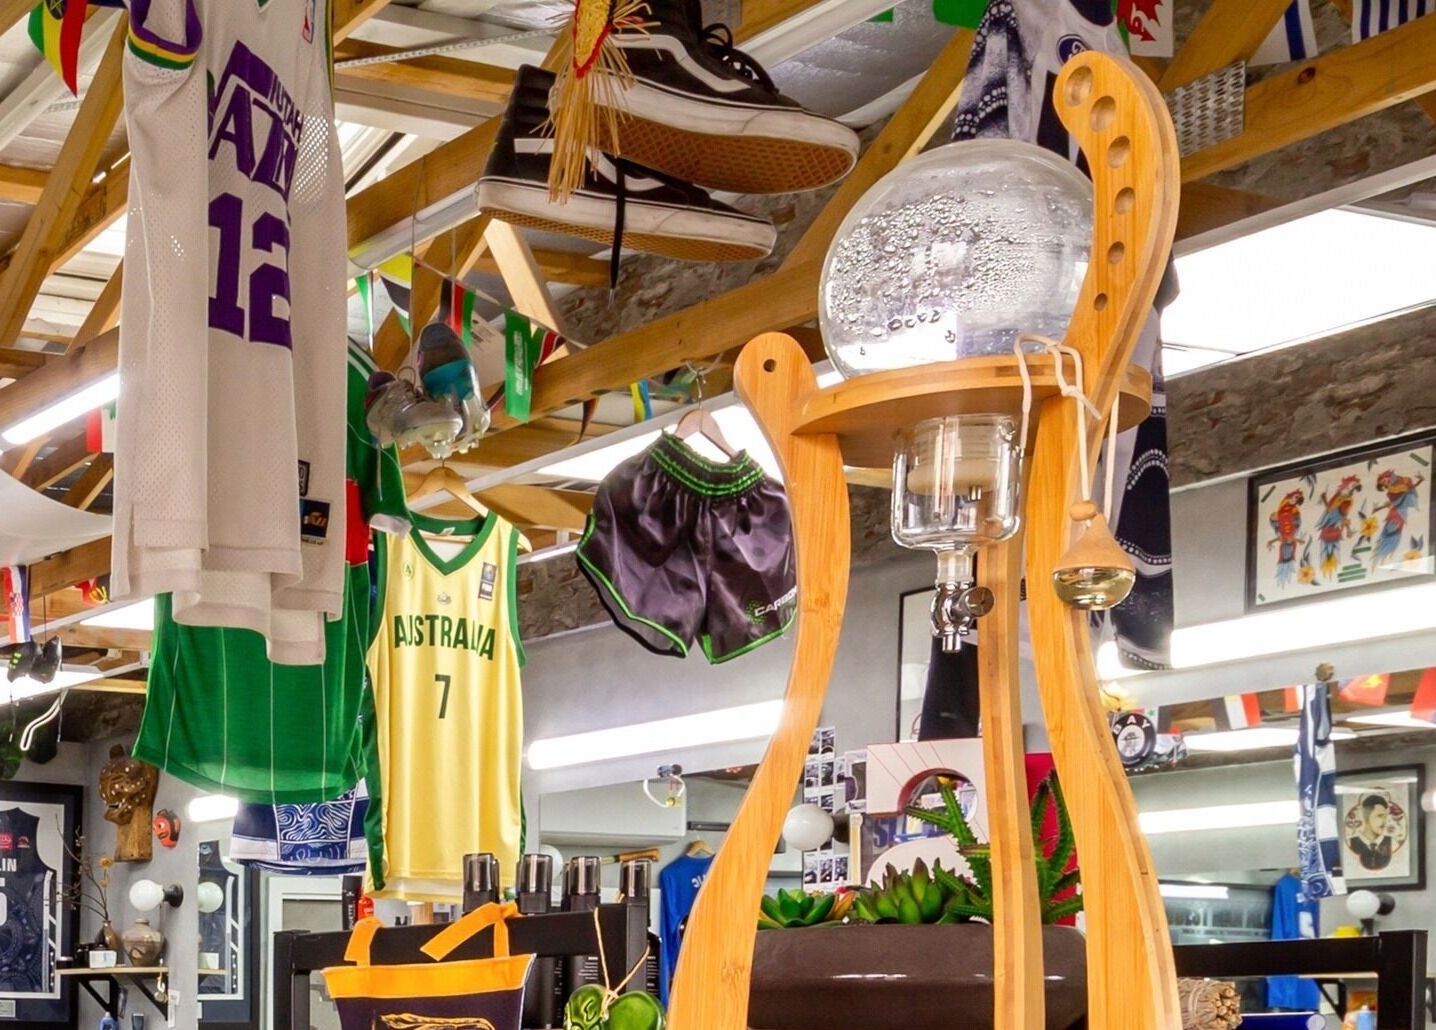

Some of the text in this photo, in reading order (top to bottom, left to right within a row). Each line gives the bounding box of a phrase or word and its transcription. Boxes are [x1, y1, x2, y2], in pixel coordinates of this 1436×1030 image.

[275, 76, 304, 143] UTAH
[208, 192, 292, 350] 12
[394, 614, 496, 661] AUSTRALIA
[434, 674, 452, 719] 7
